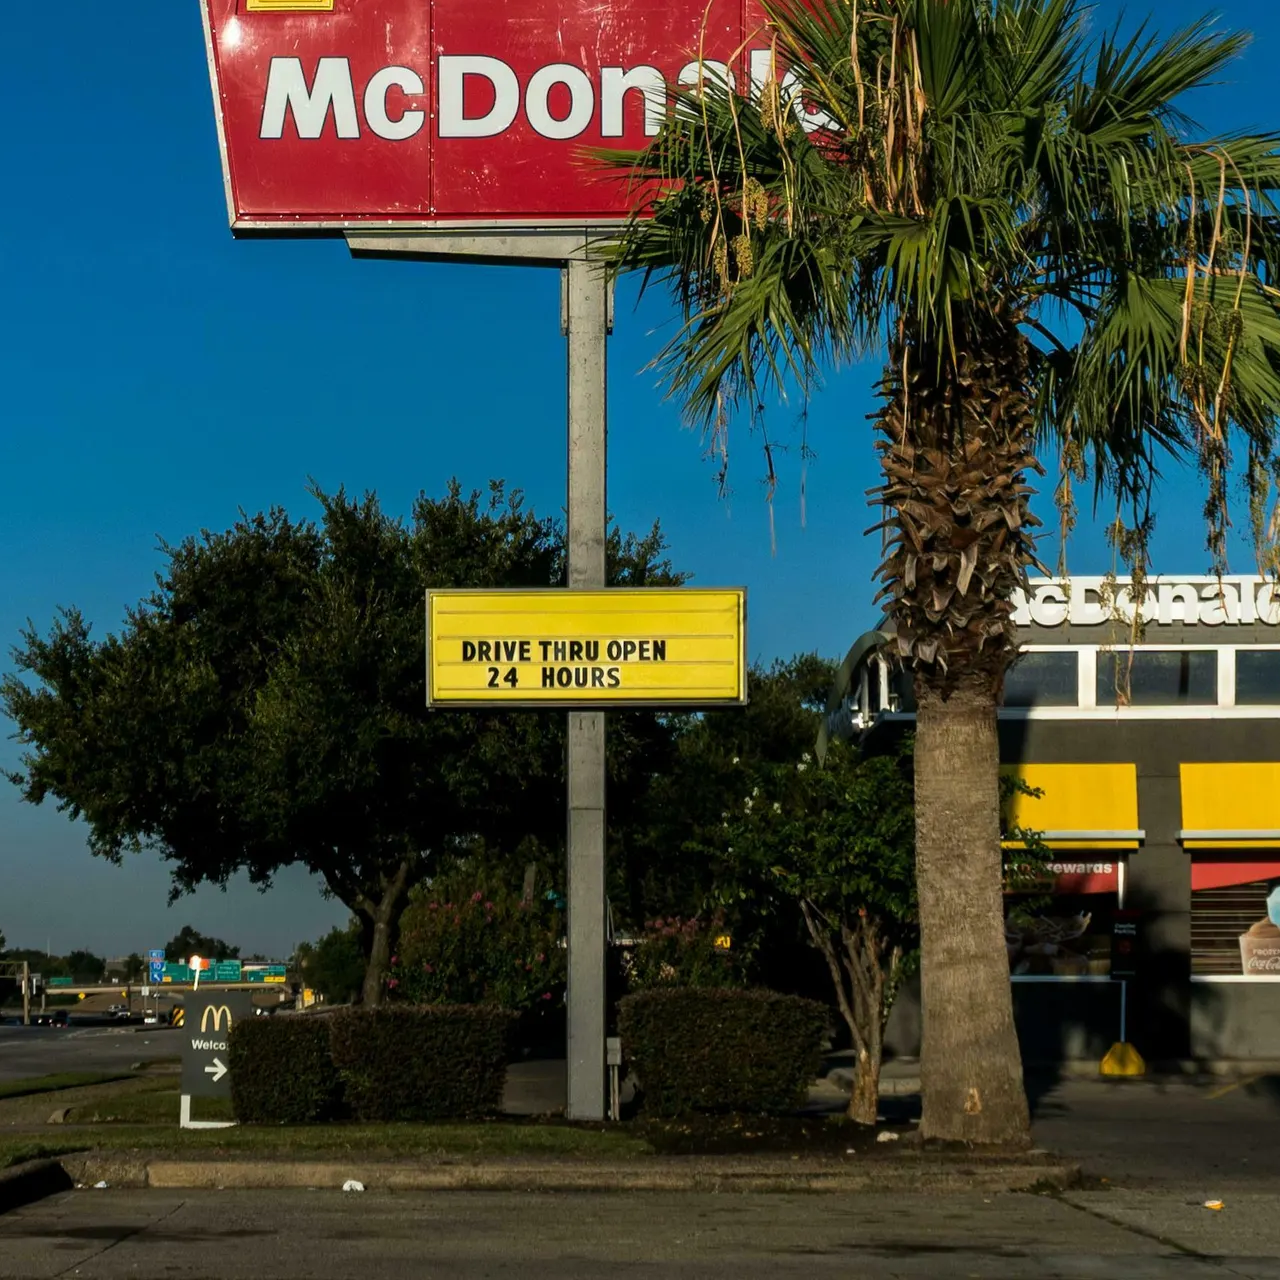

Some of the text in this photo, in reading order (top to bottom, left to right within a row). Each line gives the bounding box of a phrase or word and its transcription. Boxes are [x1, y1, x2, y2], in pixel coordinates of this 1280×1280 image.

[462, 639, 666, 662] DRIVE THRU OPEN
[487, 666, 621, 689] 24 HOURS
[191, 1039, 229, 1051] Welco
